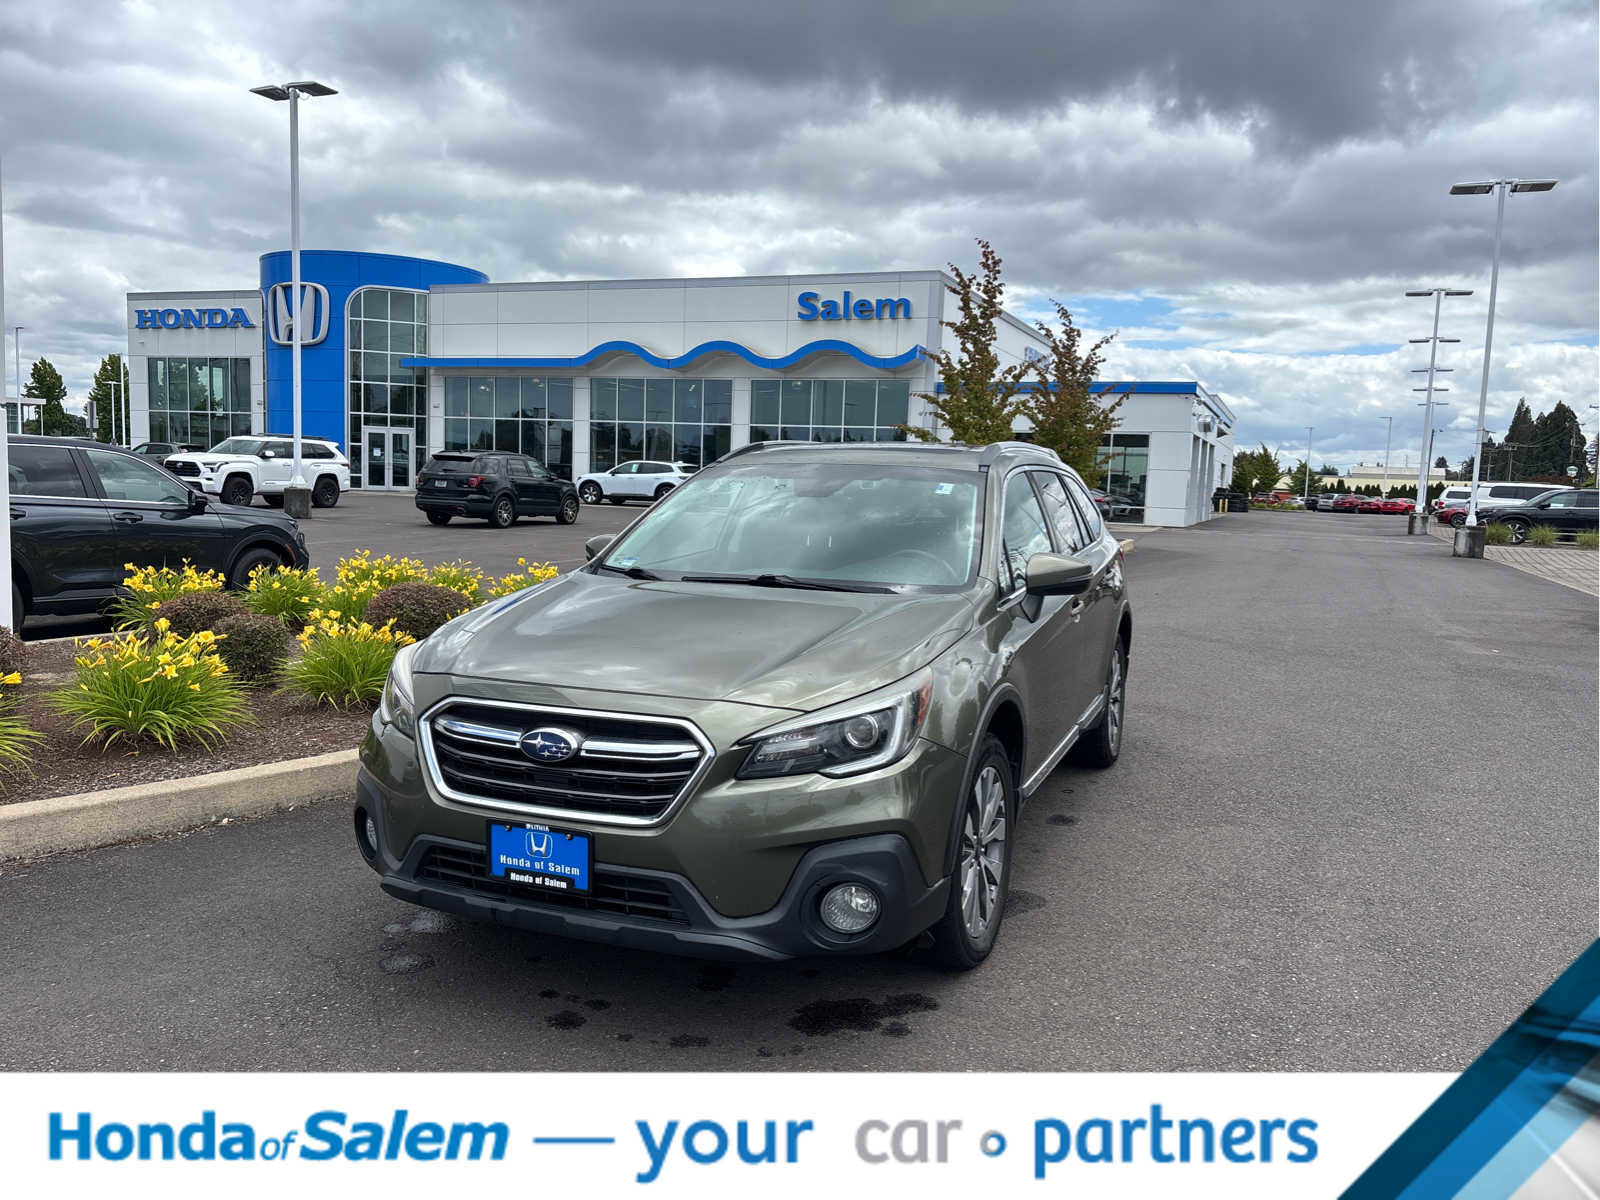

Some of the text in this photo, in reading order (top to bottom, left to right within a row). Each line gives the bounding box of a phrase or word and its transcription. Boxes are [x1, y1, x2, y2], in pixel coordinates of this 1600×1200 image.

[797, 290, 912, 320] Salem
[135, 307, 256, 328] HONDA
[500, 854, 580, 876] Honda of Salem
[510, 872, 567, 889] Honda of Salem
